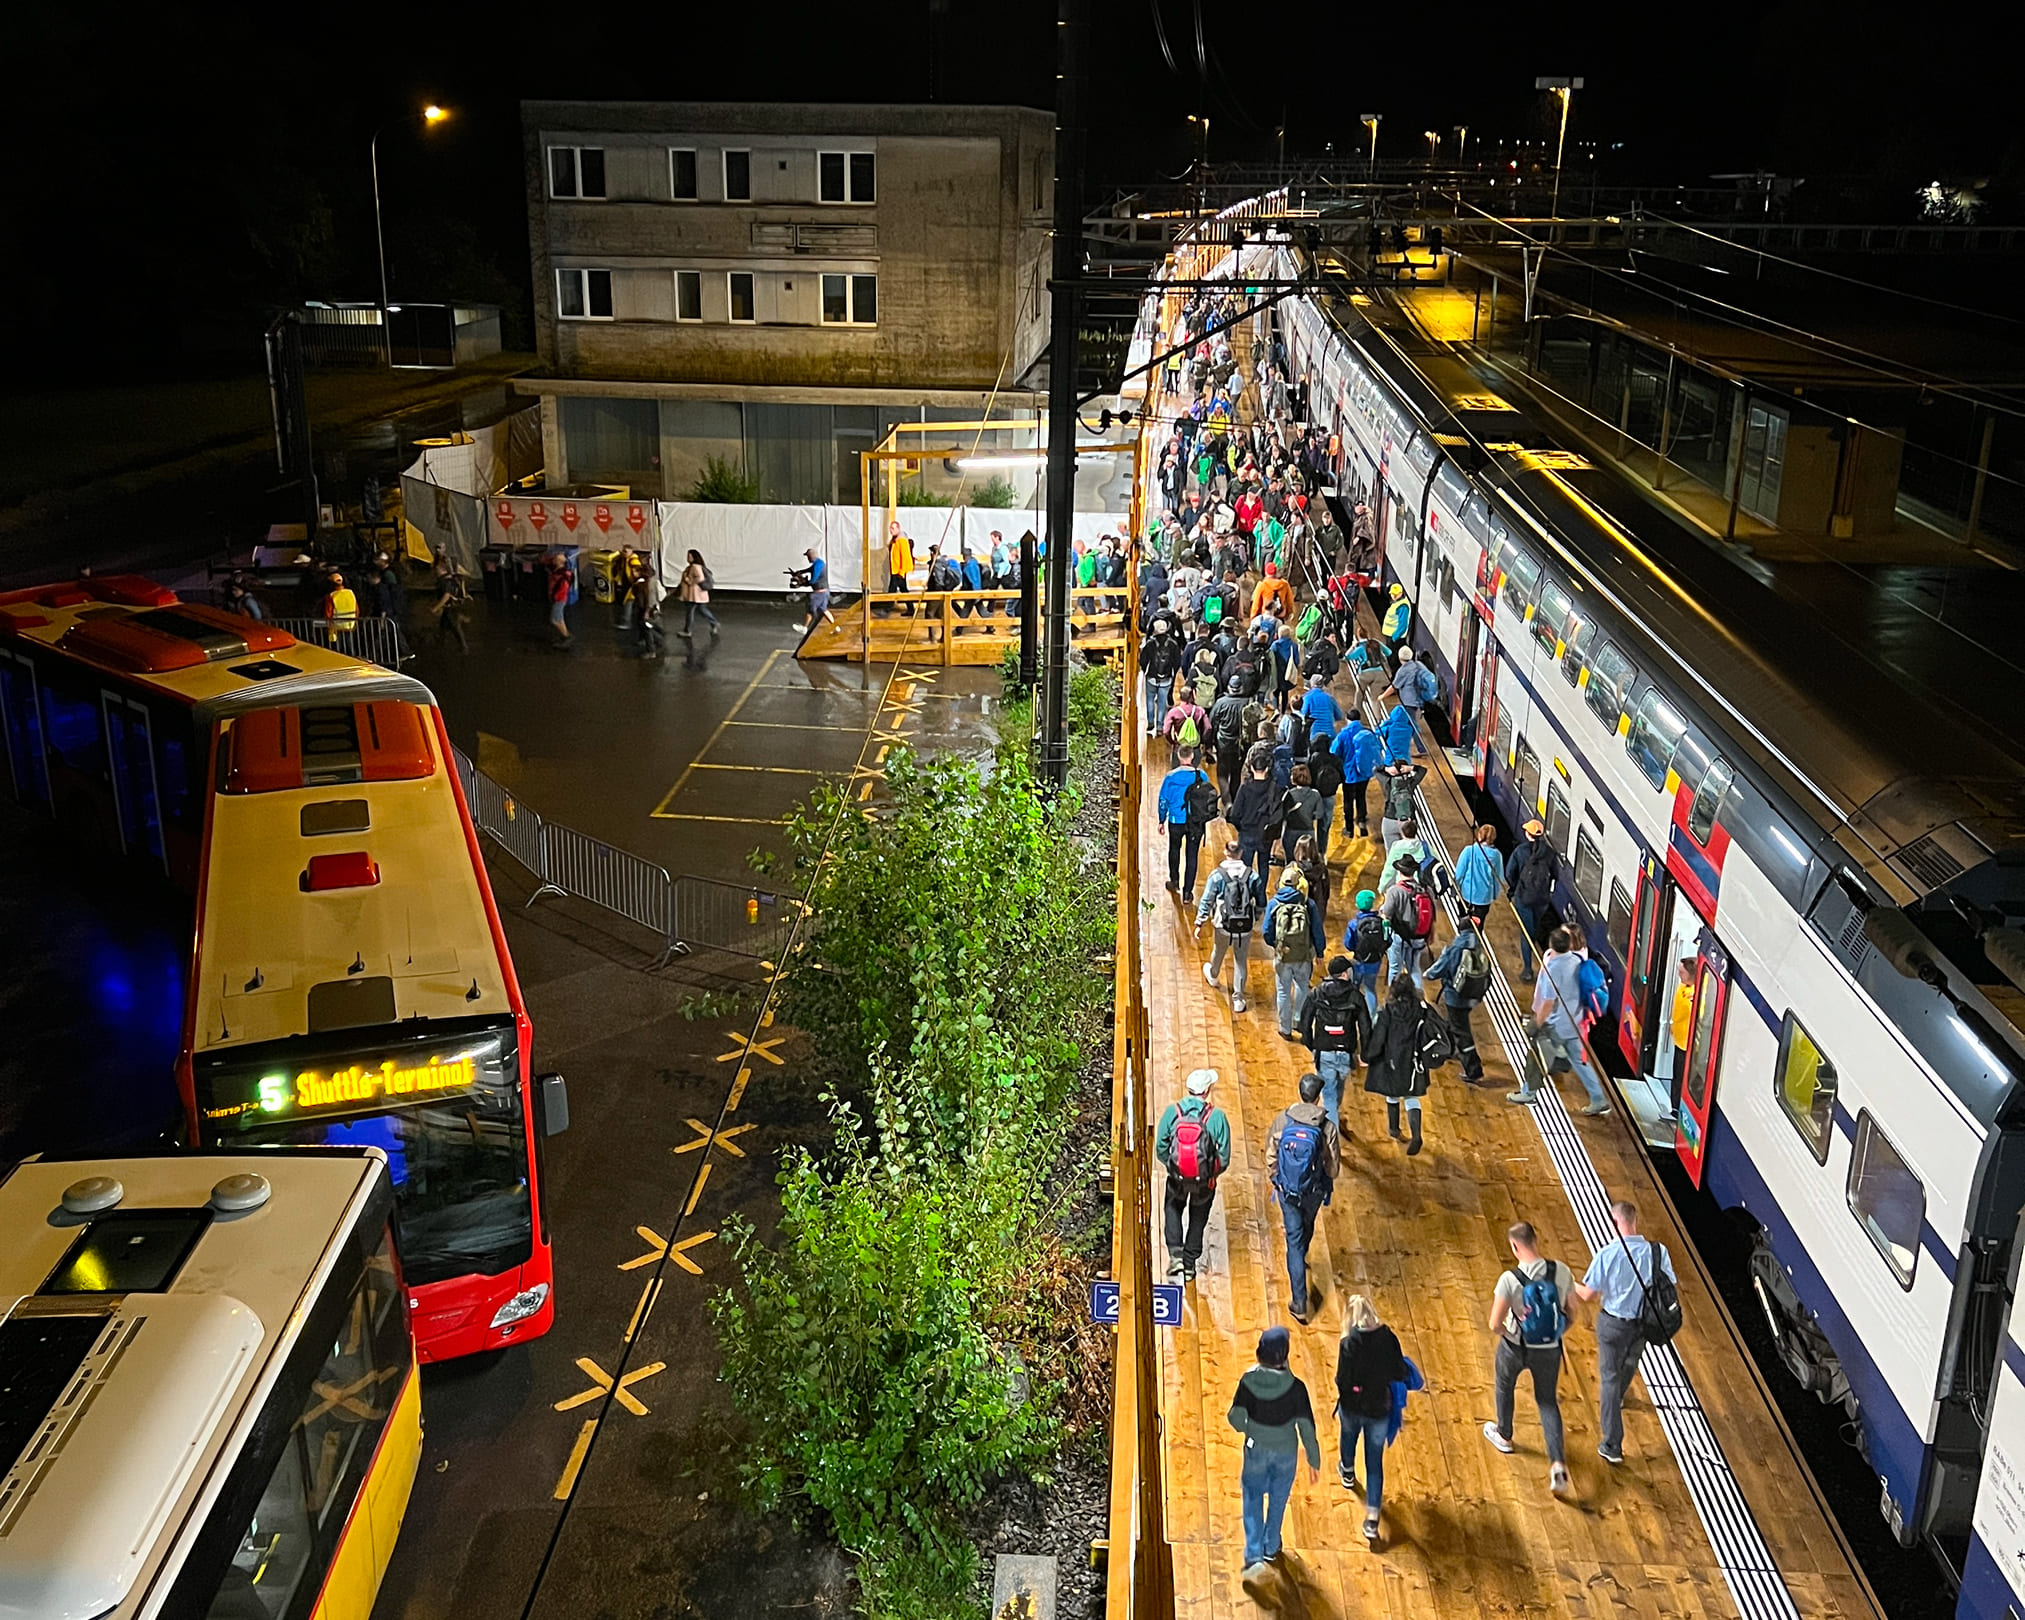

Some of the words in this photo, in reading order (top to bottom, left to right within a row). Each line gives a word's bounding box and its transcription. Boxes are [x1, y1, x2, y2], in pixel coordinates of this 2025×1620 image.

[1671, 823, 1677, 843] 1
[1640, 847, 1646, 868] 2
[1719, 957, 1728, 981] 2
[258, 1075, 286, 1112] 5
[296, 1051, 475, 1108] Shuttle-Terminal
[1106, 1294, 1119, 1316] 2
[1153, 1297, 1169, 1318] B
